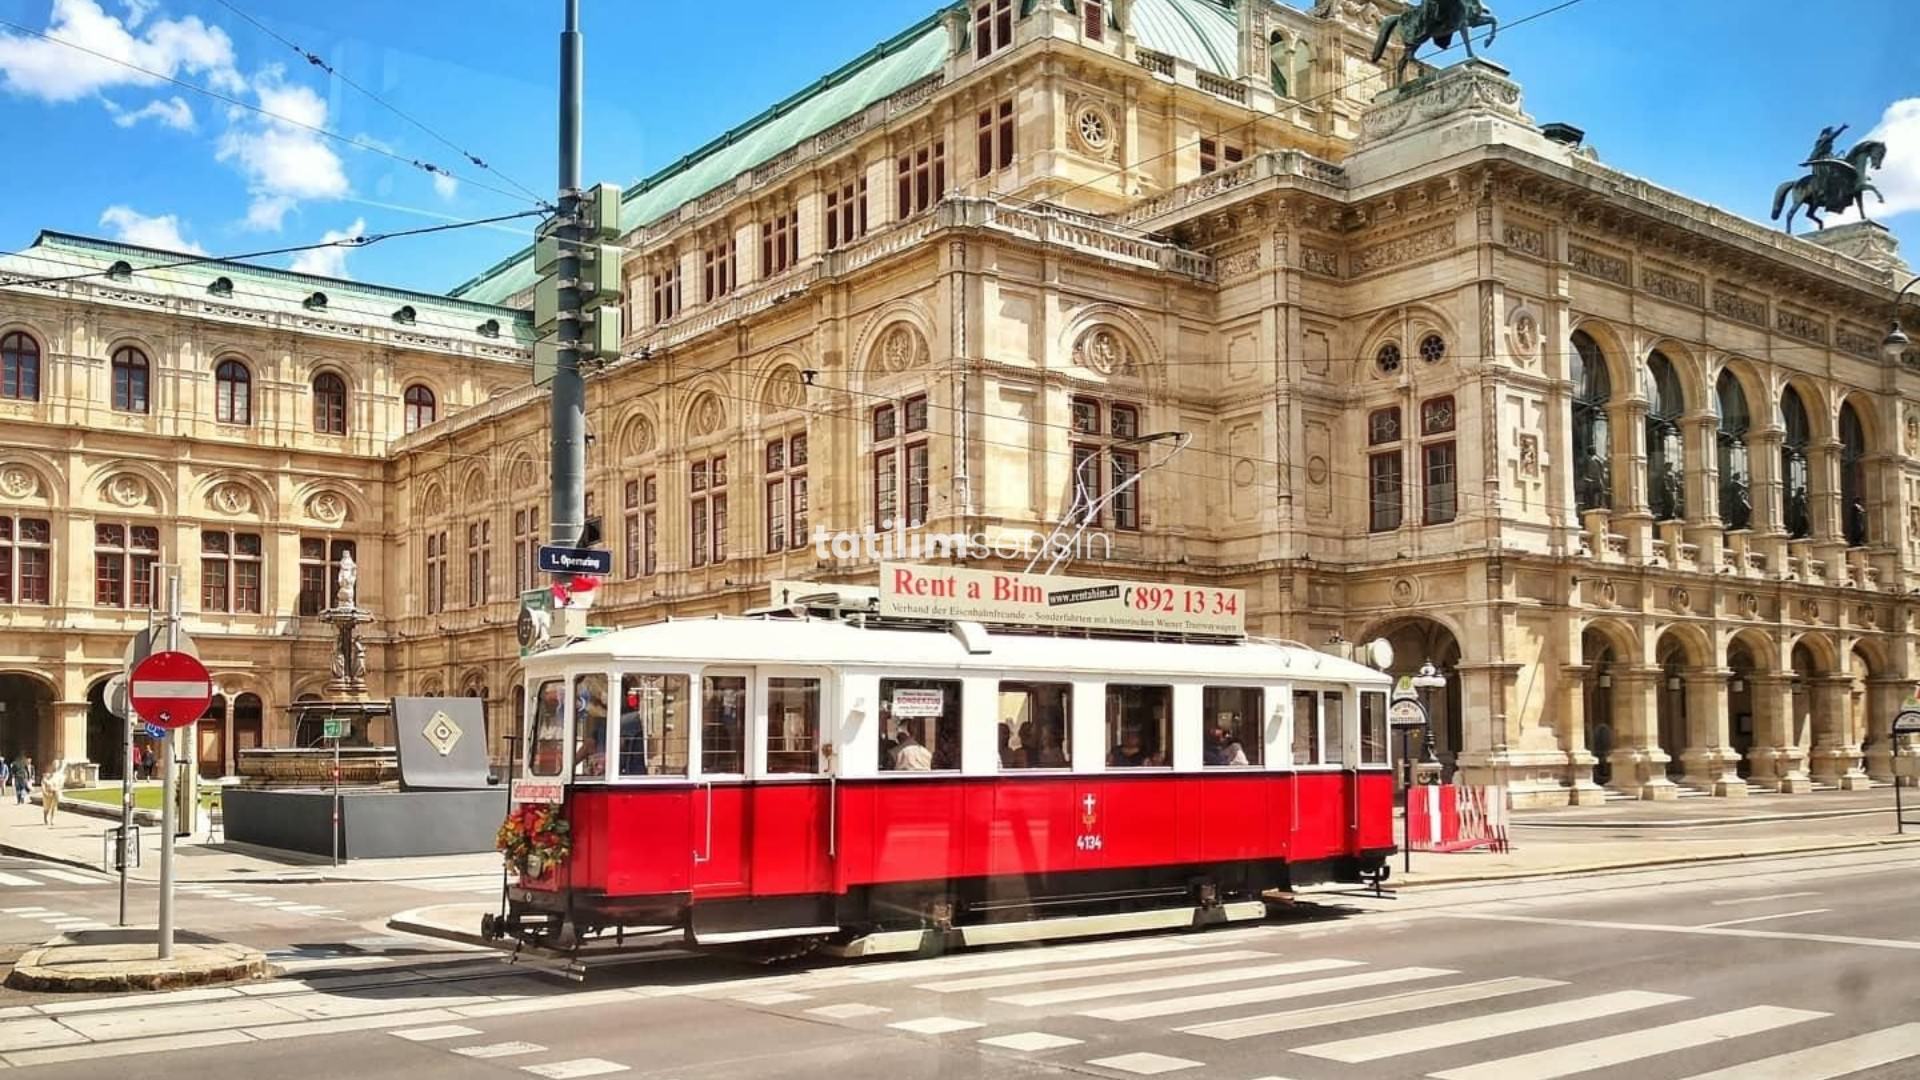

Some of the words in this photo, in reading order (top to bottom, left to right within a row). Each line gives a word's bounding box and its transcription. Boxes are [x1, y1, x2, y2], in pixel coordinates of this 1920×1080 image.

[894, 568, 957, 598] Rent
[967, 581, 981, 600] a
[993, 576, 1044, 603] Bim
[891, 603, 929, 615] Verband
[931, 605, 947, 615] der
[949, 606, 1026, 620] Eisenbahnfreunde
[1035, 611, 1092, 624] Sonderfahrten
[1134, 586, 1175, 612] 892
[1184, 589, 1206, 614] 13
[1212, 592, 1238, 616] 34
[1076, 835, 1102, 851] 4134
